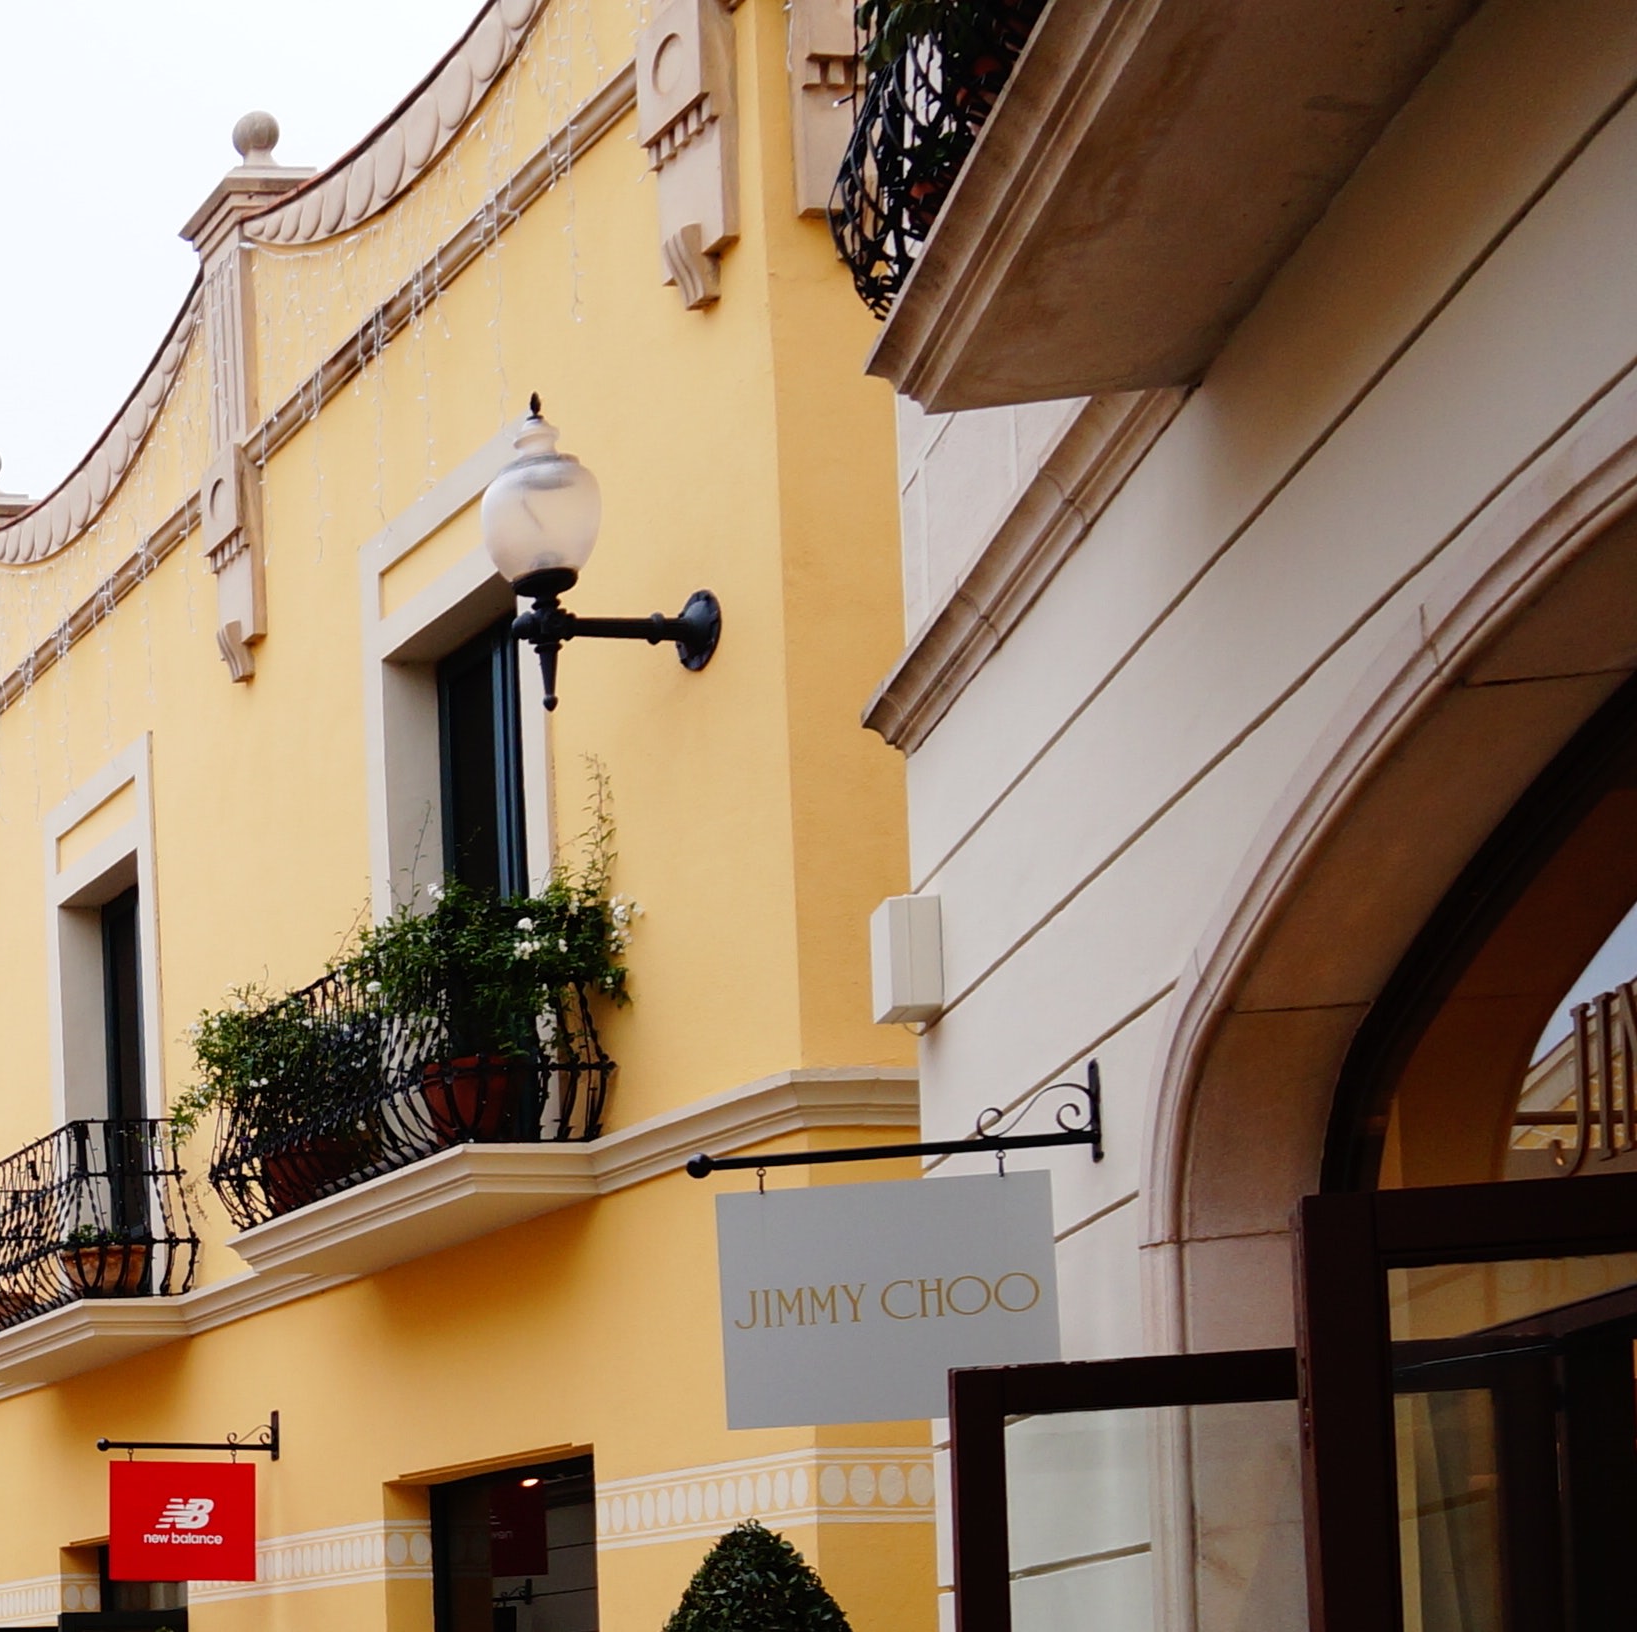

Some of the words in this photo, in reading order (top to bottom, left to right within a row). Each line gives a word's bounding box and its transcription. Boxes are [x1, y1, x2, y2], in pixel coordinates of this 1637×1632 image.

[734, 1282, 867, 1330] JIMMY
[880, 1271, 1041, 1320] CHOO
[143, 1533, 169, 1544] new
[171, 1531, 224, 1545] balance
